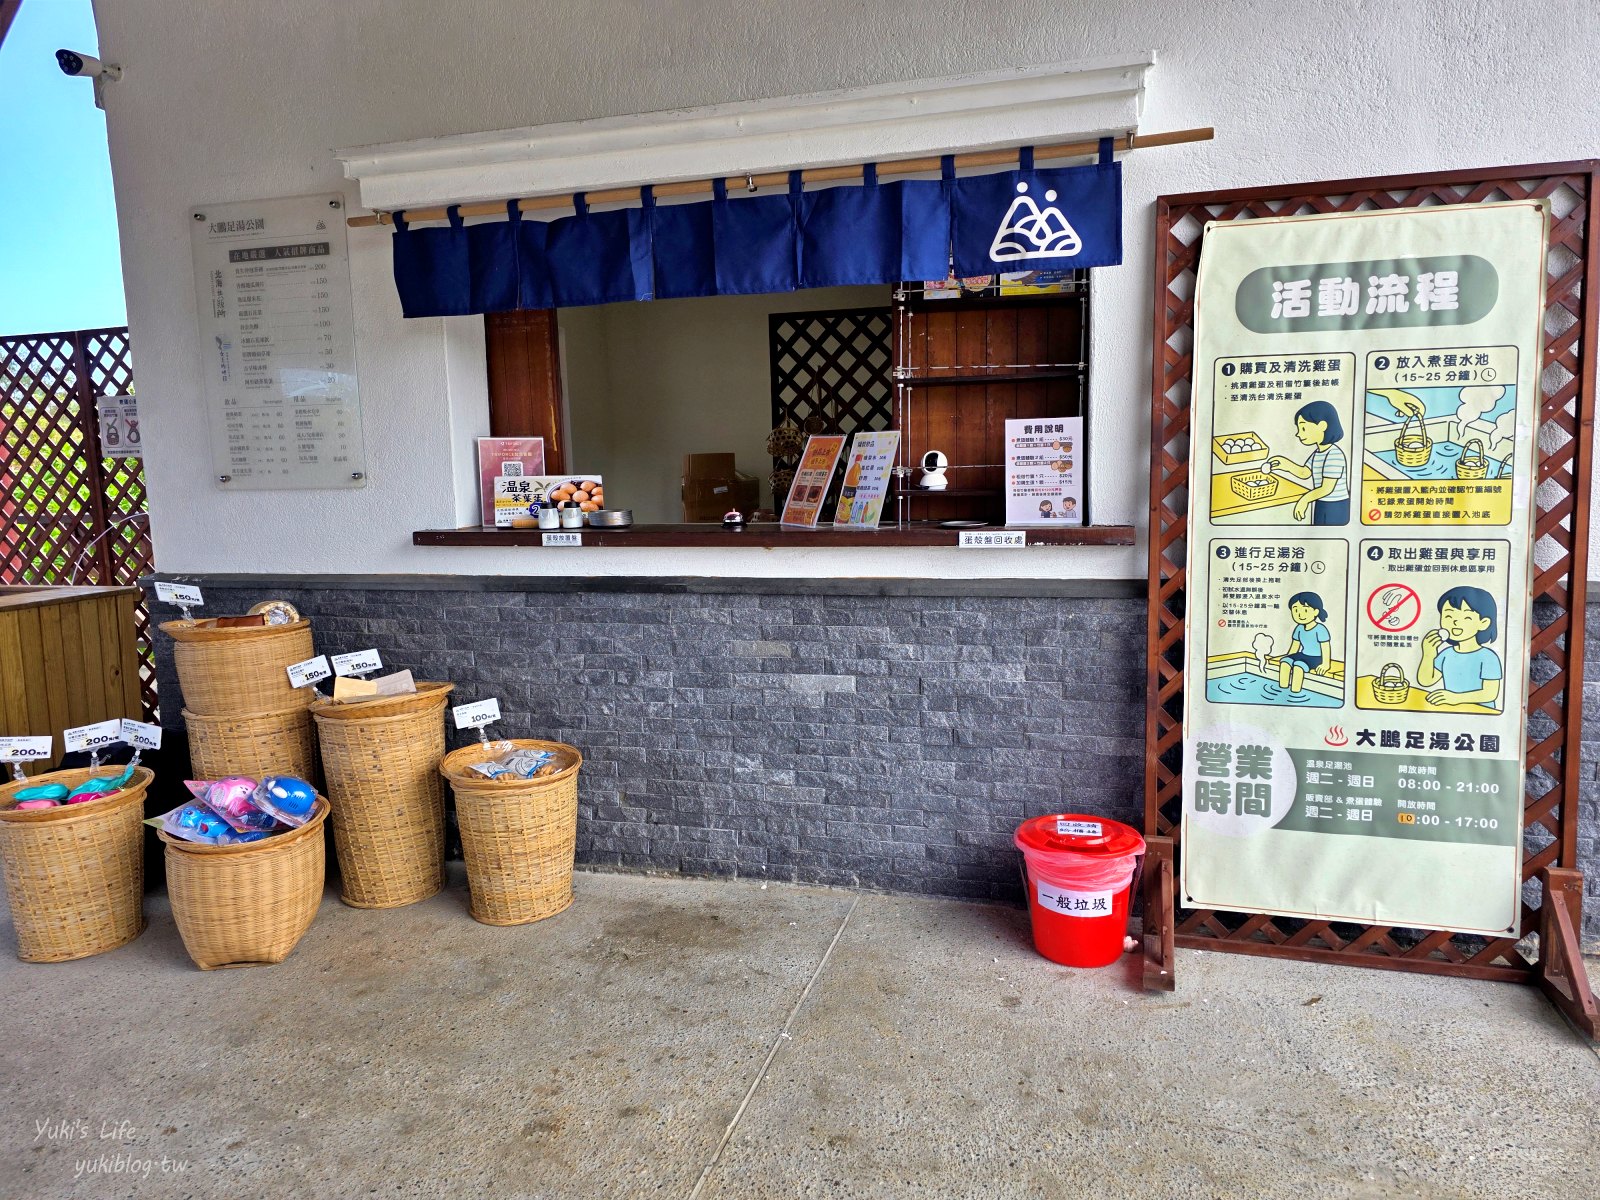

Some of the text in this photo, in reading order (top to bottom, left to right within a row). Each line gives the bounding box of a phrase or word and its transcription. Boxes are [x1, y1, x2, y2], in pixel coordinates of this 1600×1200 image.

[208, 218, 265, 234] 大鵬足湯公園
[1270, 270, 1459, 320] 活動流程
[1239, 359, 1341, 375] 購買及清洗雞蛋
[1396, 352, 1490, 369] 放入煮蛋水池
[1230, 392, 1302, 402] 至清洗台清洗雞蛋
[1024, 424, 1064, 434] 費用說明
[1377, 497, 1454, 506] 記錄煮蛋開始時間
[1384, 510, 1491, 518] 請勿將雞蛋直接置入池底
[964, 536, 1024, 544] 蛋殼盤回收處
[1234, 546, 1306, 559] 進行足湯浴
[1388, 547, 1496, 560] 取出雞蛋與享用
[1355, 728, 1500, 753] 大鵬足湯公園
[1196, 742, 1274, 780] 營業
[1305, 760, 1353, 770] 溫泉足湯池
[1398, 765, 1437, 776] 開放時間
[1306, 772, 1334, 785] 週二
[1347, 774, 1375, 788] 週日
[1398, 778, 1441, 791] 08:00
[1456, 781, 1500, 794] 21:00
[1194, 780, 1272, 818] 時間
[1305, 794, 1334, 804] 販賣部
[1345, 796, 1383, 807] 煮蛋體驗
[1397, 800, 1436, 810] 開放時間
[1305, 806, 1333, 819] 週二
[1346, 808, 1374, 822] 週日
[1455, 816, 1499, 829] 17:00
[1042, 893, 1108, 911] 一般垃圾
